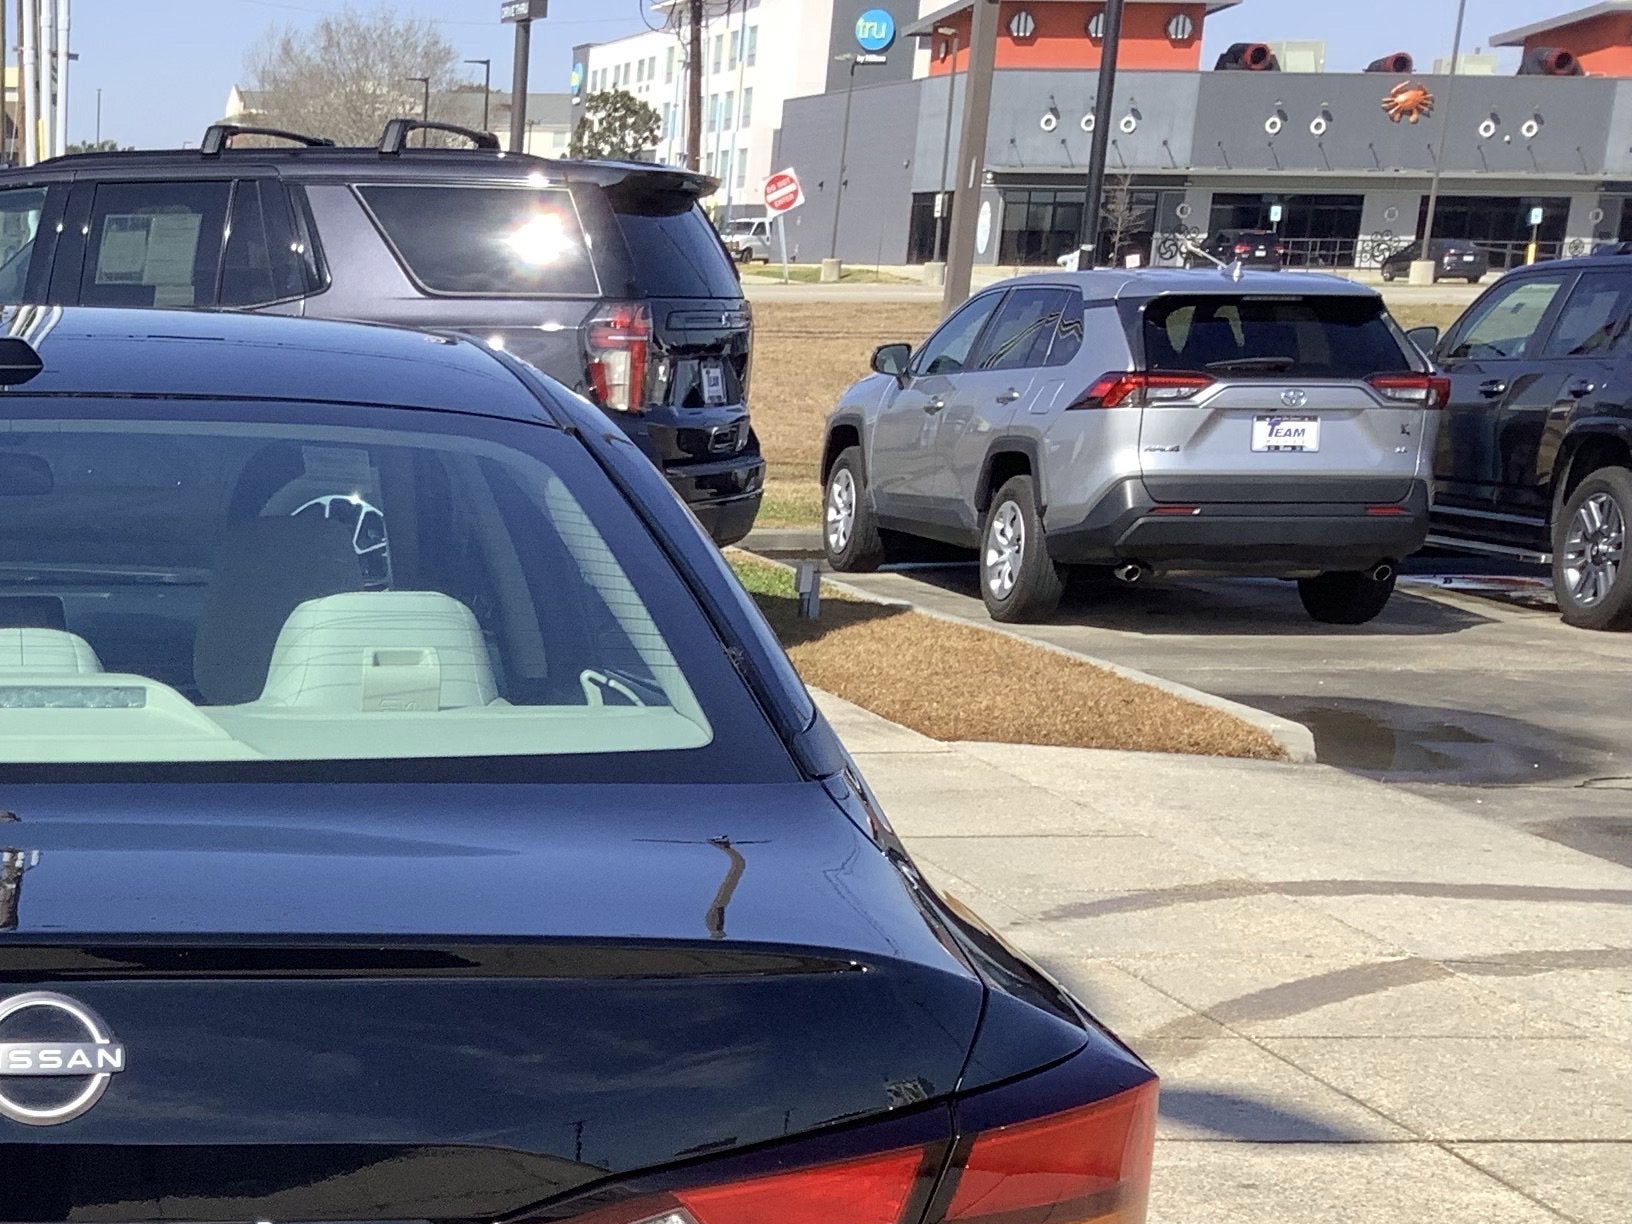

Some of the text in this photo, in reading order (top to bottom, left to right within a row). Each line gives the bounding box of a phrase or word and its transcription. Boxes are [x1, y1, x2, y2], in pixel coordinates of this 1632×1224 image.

[856, 17, 887, 39] tru
[773, 193, 795, 208] ENTER
[1267, 417, 1306, 438] TEAM
